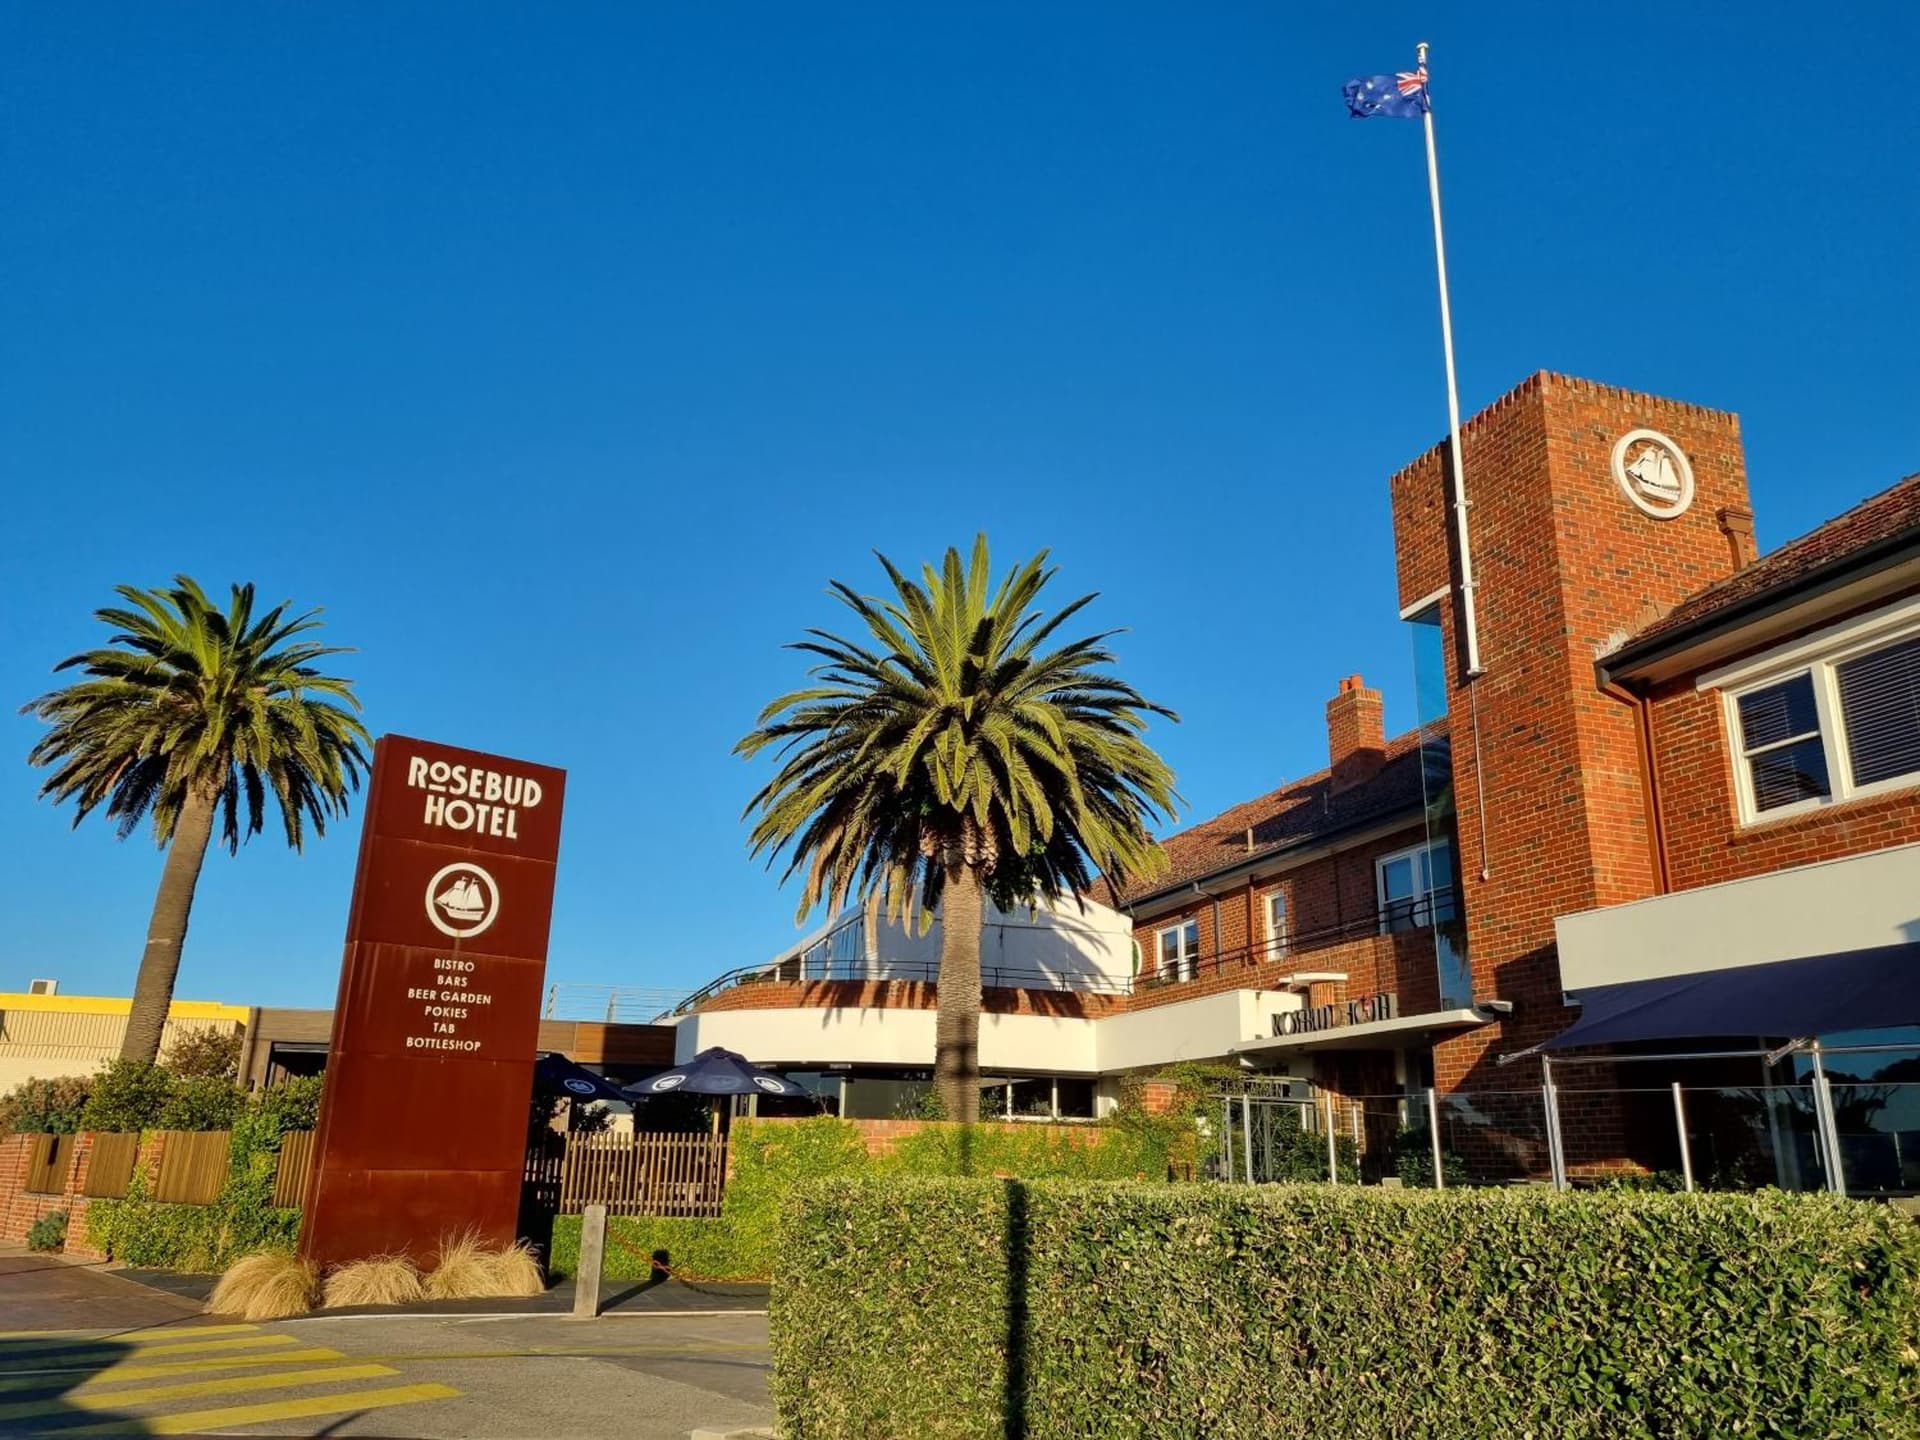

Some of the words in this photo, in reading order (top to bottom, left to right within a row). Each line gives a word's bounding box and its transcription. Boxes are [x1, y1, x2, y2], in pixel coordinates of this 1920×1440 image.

[407, 756, 543, 808] ROSEBUD
[424, 795, 518, 840] HOTEL
[433, 958, 475, 973] BISTRO
[437, 974, 468, 987] BARS
[407, 987, 437, 1001] BEER
[440, 990, 492, 1005] GARDEN
[424, 1005, 468, 1019] POKIES
[432, 1022, 456, 1034] TAB
[406, 1036, 481, 1052] BOTTLESHOP
